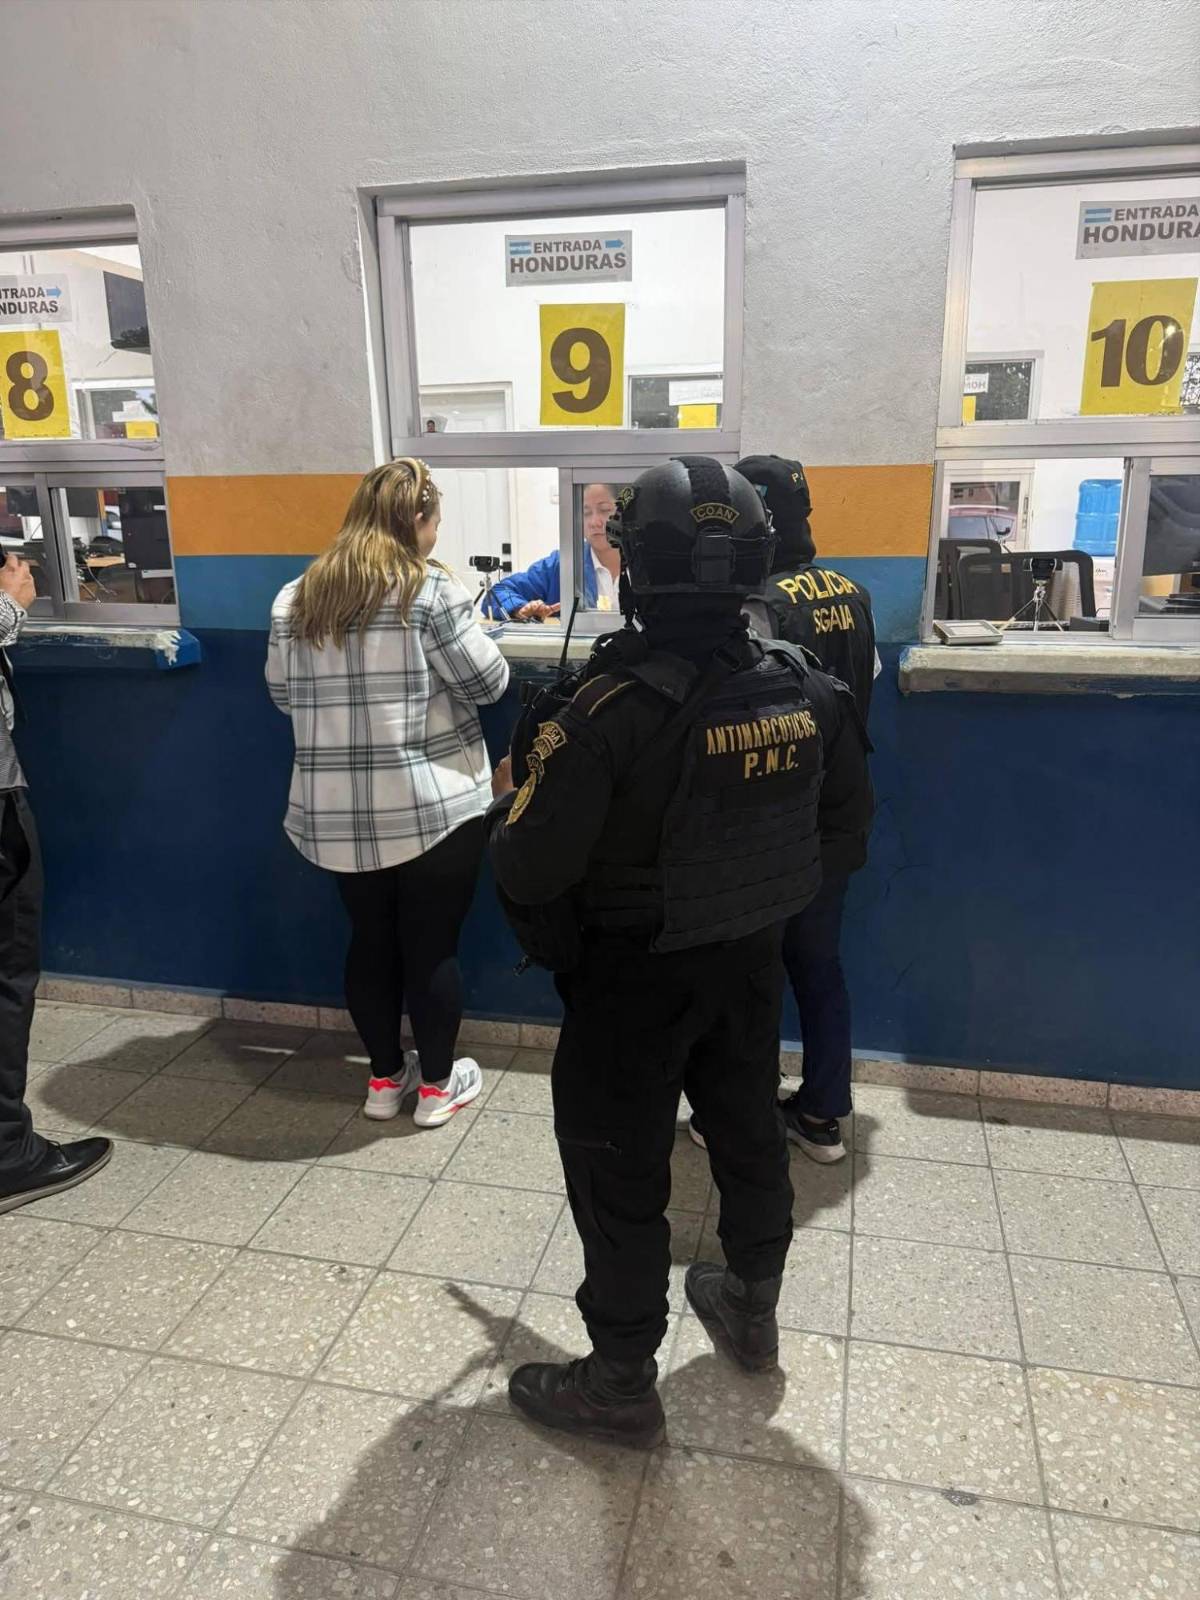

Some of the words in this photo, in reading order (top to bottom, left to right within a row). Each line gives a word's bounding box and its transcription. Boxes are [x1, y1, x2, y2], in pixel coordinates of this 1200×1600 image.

[1114, 204, 1199, 221] ENTRADA
[510, 252, 627, 273] HONDURAS
[534, 240, 602, 253] ENTRADA
[0, 287, 46, 299] TRADA
[1091, 314, 1184, 388] 10
[6, 350, 55, 421] 8
[550, 327, 612, 414] 9
[697, 505, 734, 520] COAN
[776, 569, 860, 604] POLICIA
[813, 604, 855, 635] SGAIA
[706, 710, 816, 755] ANTINARCOTICOS
[744, 744, 800, 780] P.N.C.
